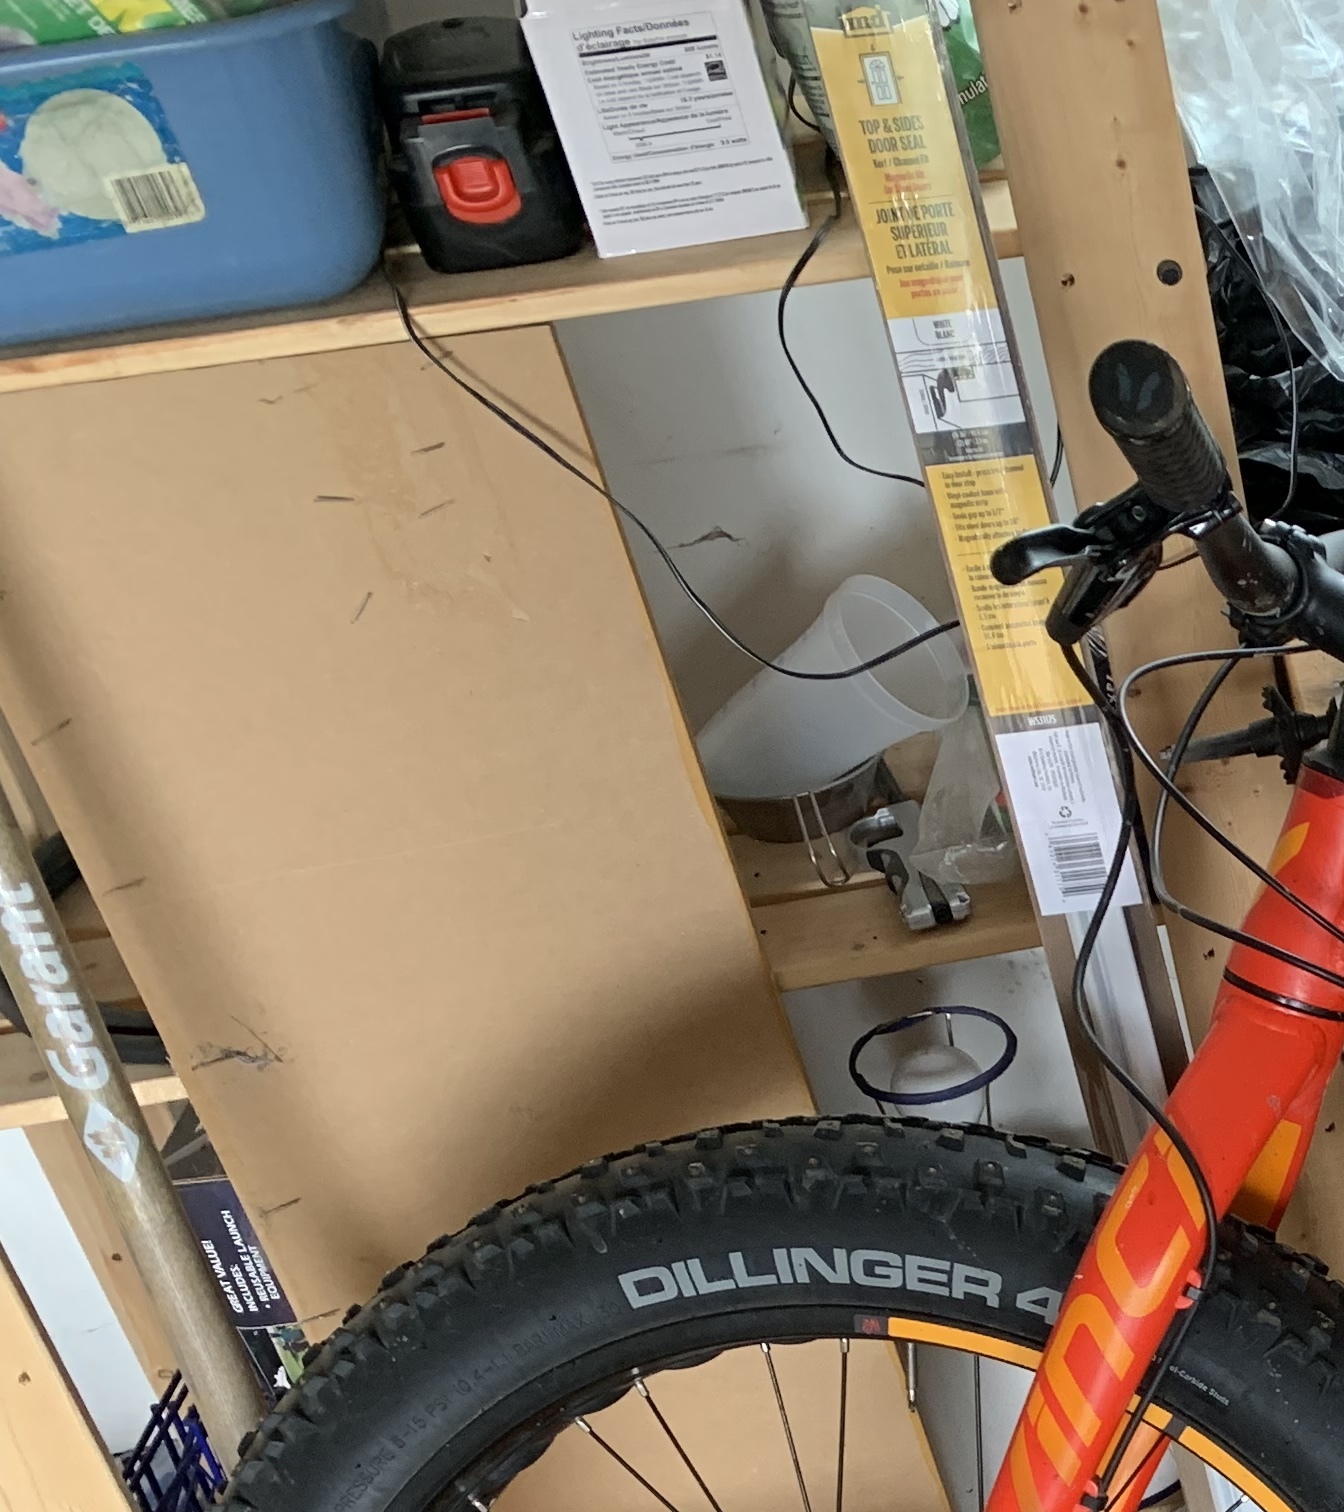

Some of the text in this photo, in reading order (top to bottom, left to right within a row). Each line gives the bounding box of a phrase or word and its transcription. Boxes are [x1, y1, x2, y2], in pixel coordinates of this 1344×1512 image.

[572, 19, 690, 42] Lighting Facts/Données
[858, 115, 925, 135] TOP & SIDES
[868, 134, 927, 154] DOOR SEAL
[876, 206, 905, 225] JOINT
[920, 202, 955, 219] PORTE
[896, 244, 908, 259] ET
[933, 319, 952, 329] WHITE
[935, 330, 955, 340] BLANC
[0, 881, 109, 1091] Garant
[221, 1210, 270, 1302] REUSABLE LAUNCH
[201, 1240, 244, 1313] GREAT VALUE!
[248, 1245, 280, 1300] EQUIPMENT
[618, 1247, 1064, 1325] DILLINGER 4
[1168, 1364, 1208, 1392] el-Carbide
